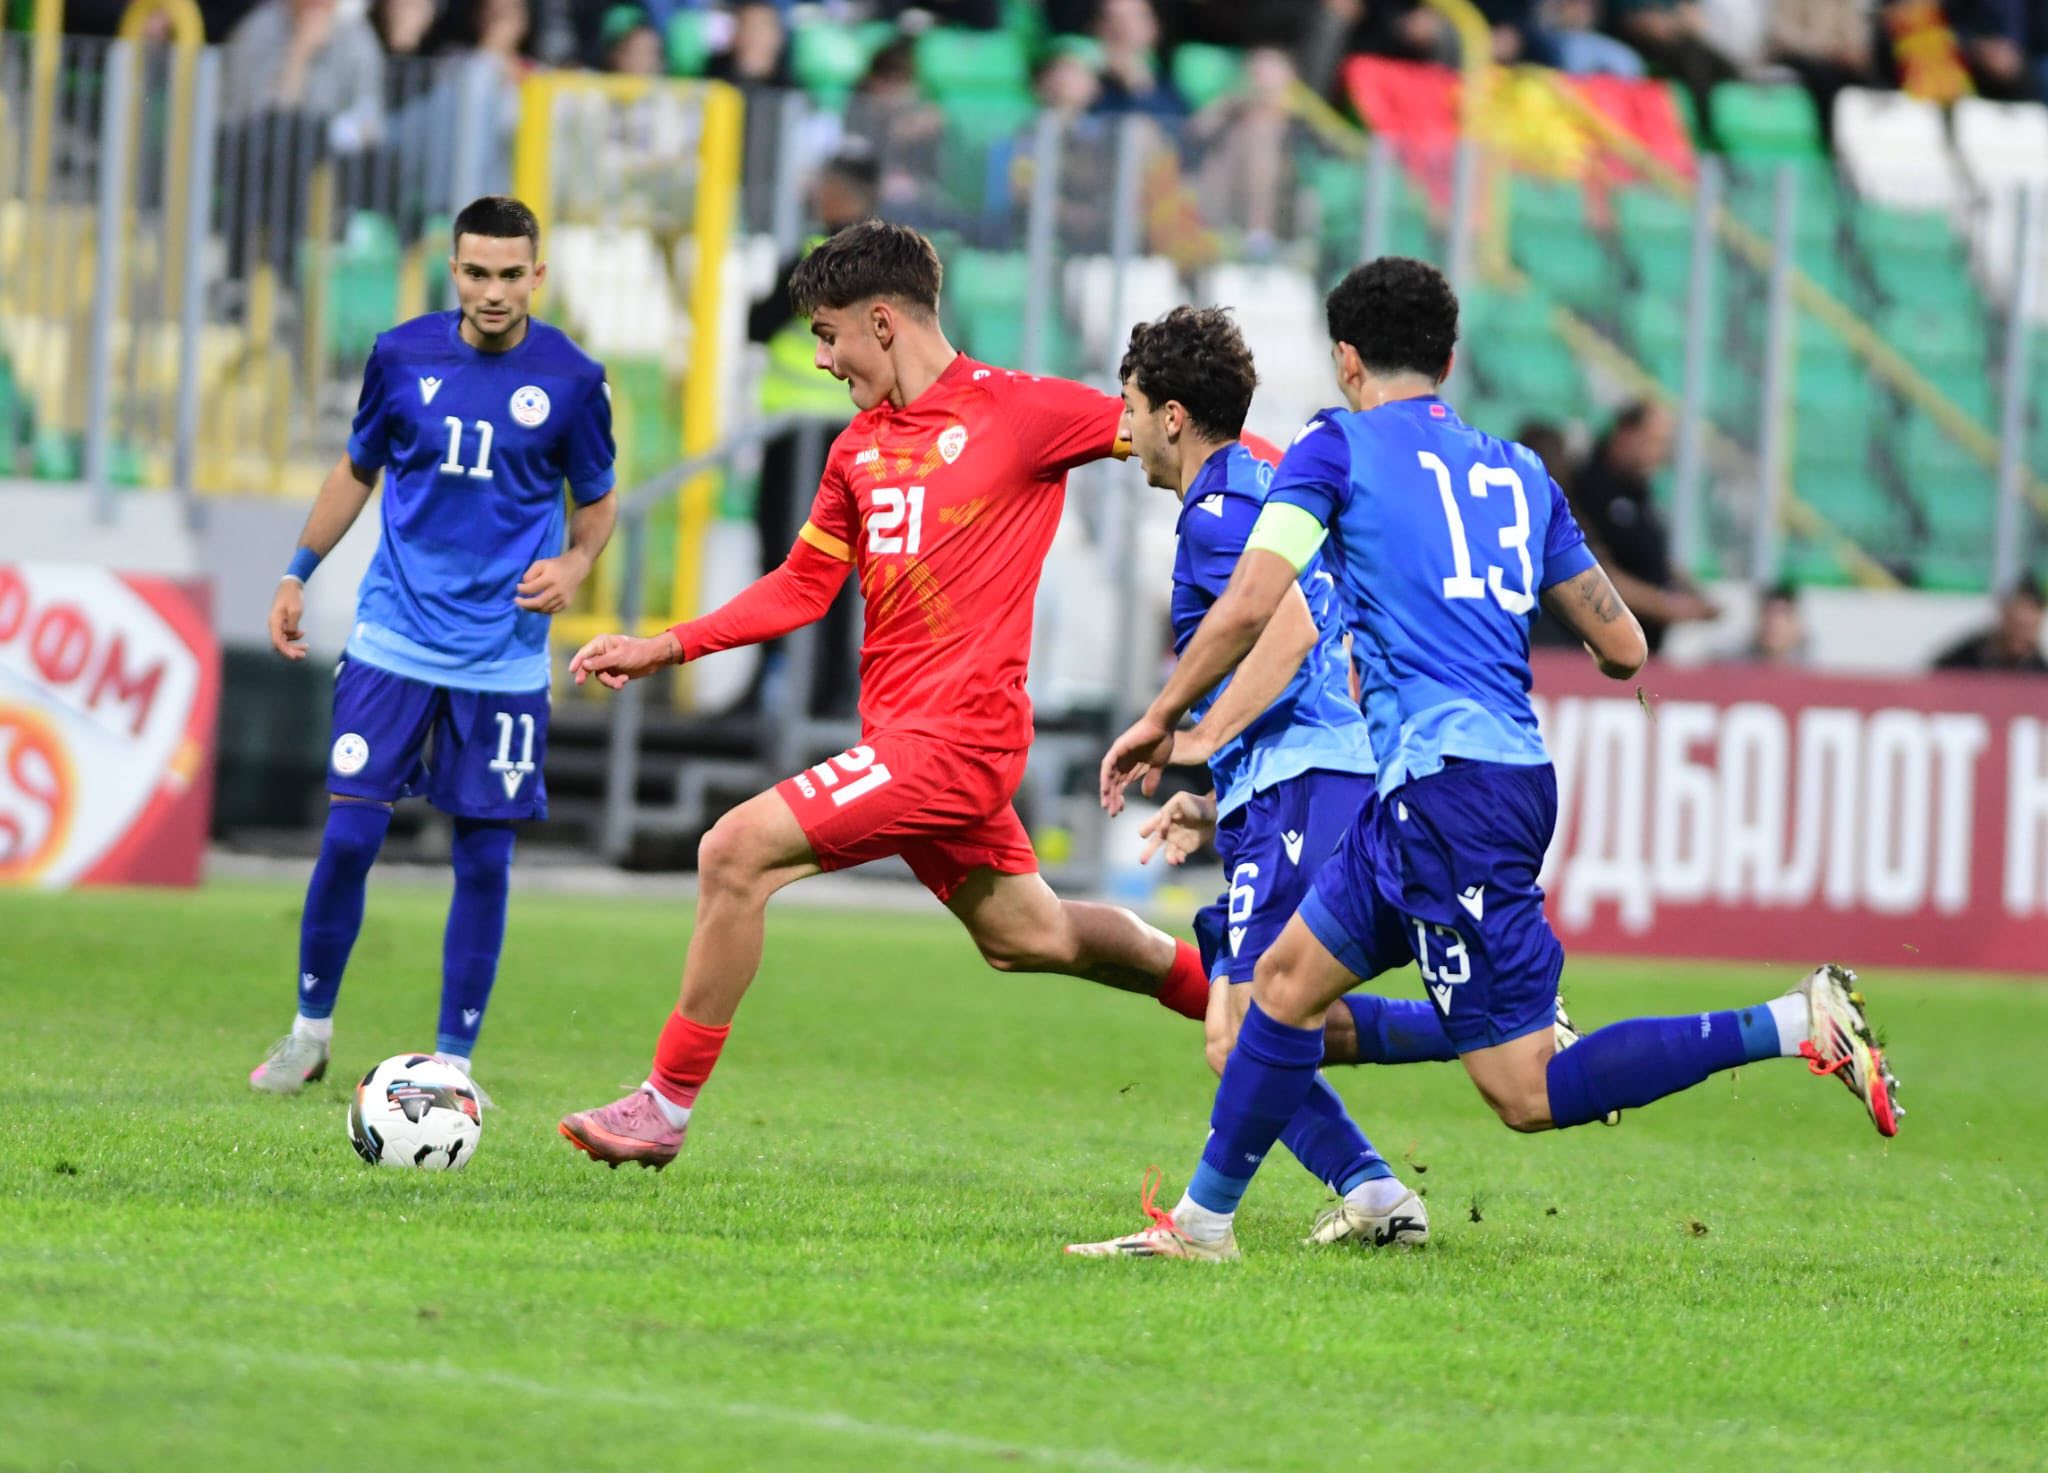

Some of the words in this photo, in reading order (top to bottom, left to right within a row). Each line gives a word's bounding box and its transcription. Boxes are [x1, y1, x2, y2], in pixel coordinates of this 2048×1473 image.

[439, 415, 494, 479] 11
[866, 485, 926, 555] 21
[1416, 450, 1535, 616] 13
[488, 711, 536, 772] 11
[812, 744, 893, 808] 21
[1228, 862, 1260, 924] 6
[1411, 917, 1471, 985] 13
